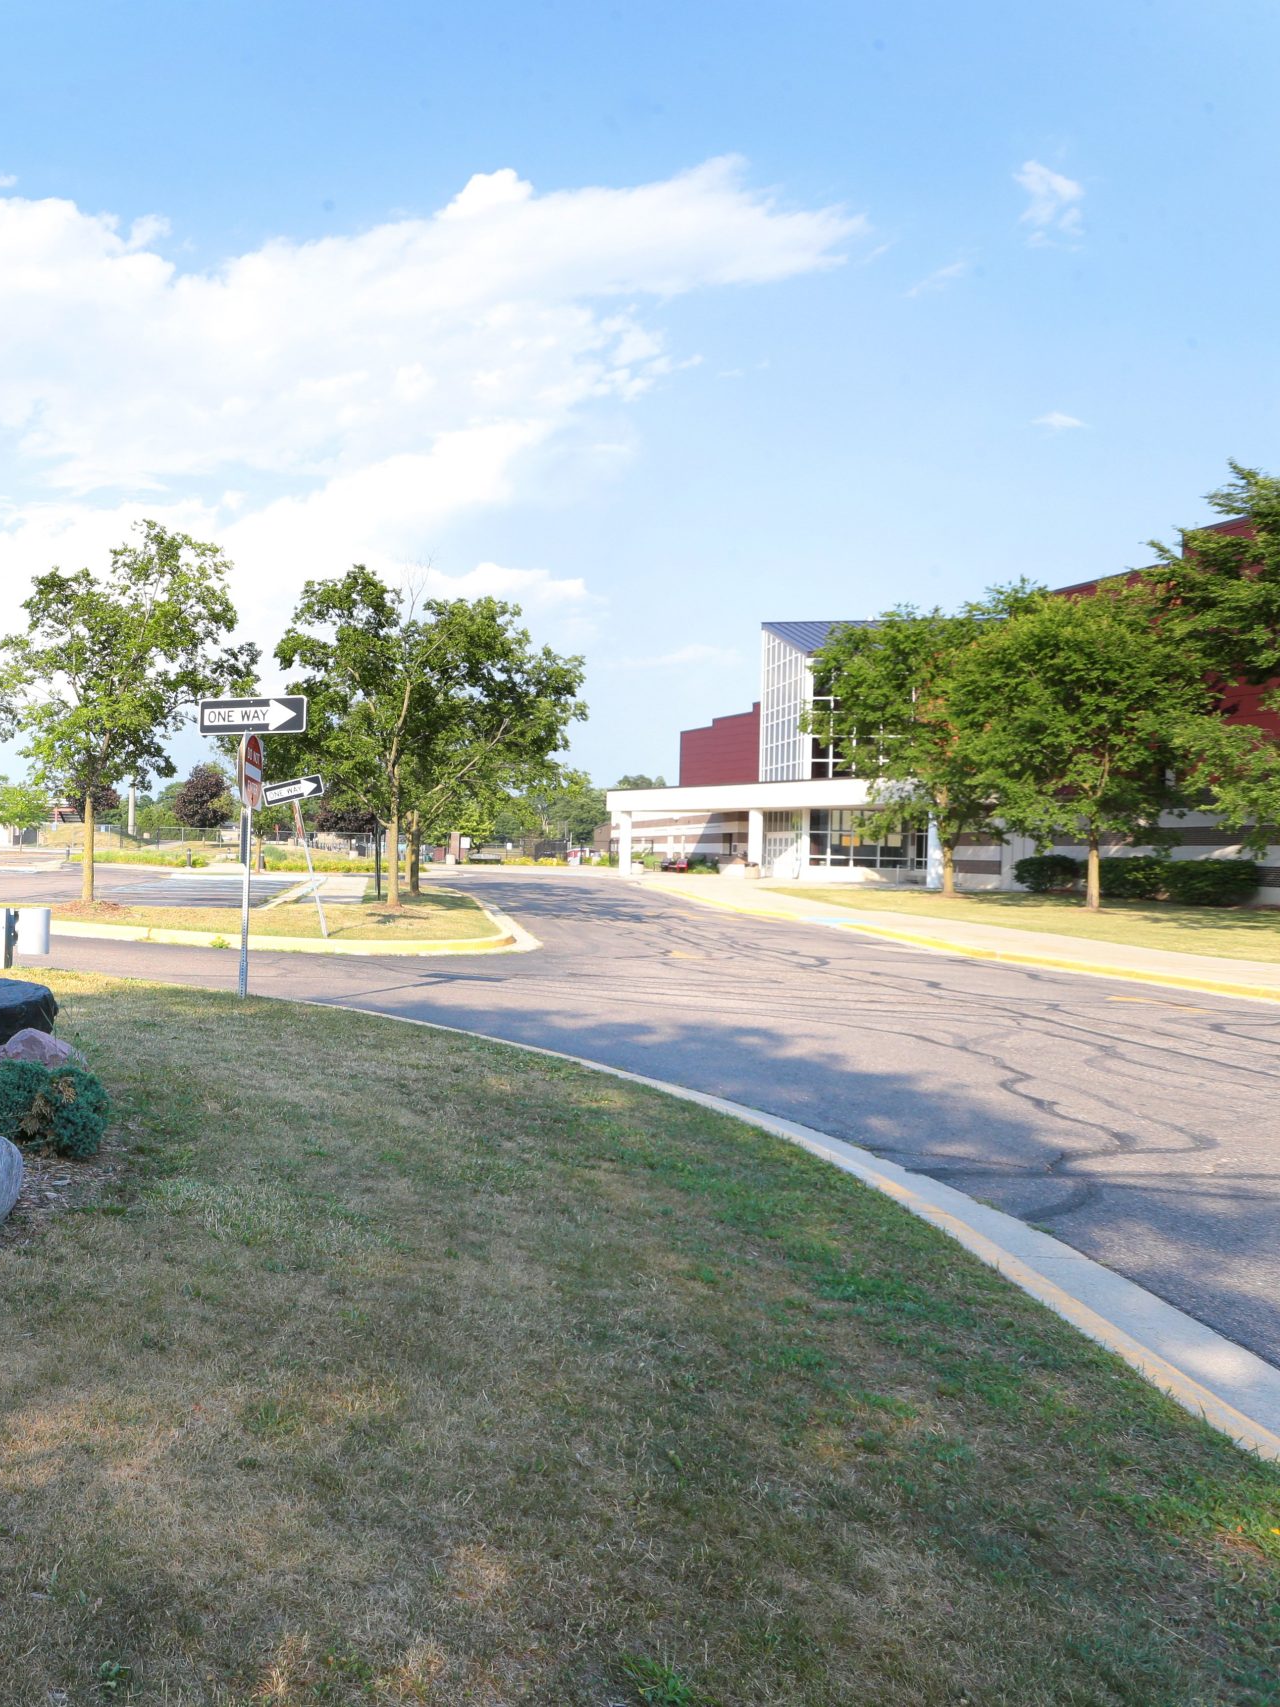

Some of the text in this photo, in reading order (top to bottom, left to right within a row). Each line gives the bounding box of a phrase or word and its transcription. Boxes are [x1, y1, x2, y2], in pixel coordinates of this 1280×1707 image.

[207, 709, 269, 723] ONE WAY
[269, 786, 302, 799] ONE WAY
